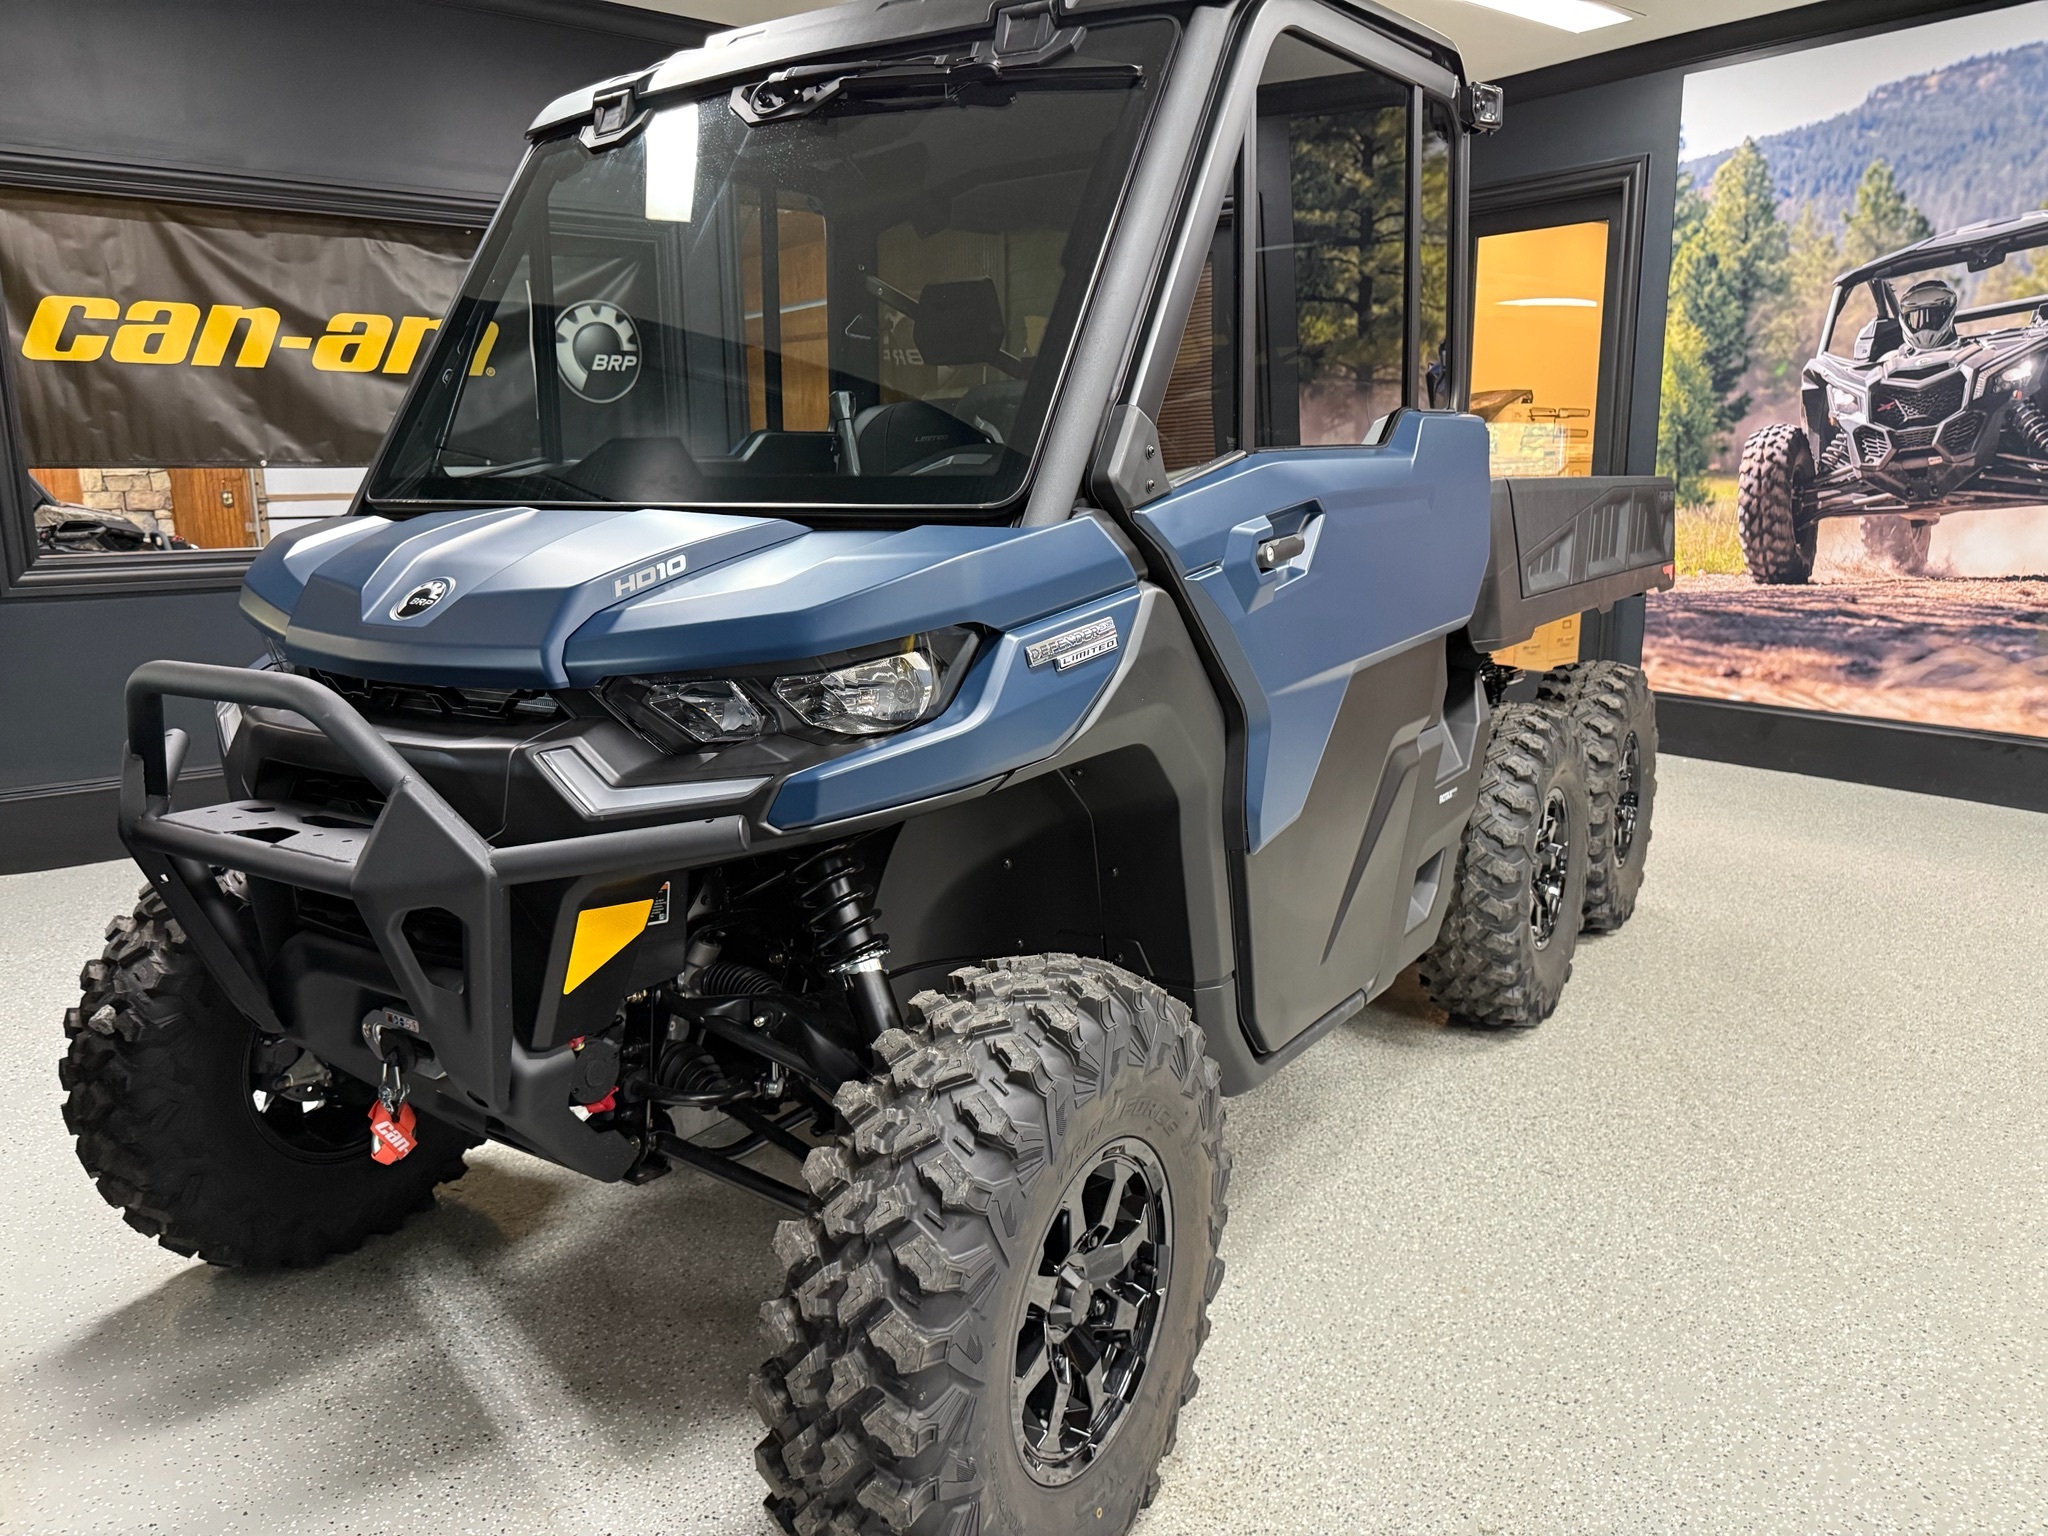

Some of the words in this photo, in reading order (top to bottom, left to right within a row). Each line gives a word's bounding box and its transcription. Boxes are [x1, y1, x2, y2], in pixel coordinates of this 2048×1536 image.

[592, 354, 637, 371] BRP
[614, 554, 687, 598] HD10
[409, 597, 434, 606] BRP
[1029, 624, 1100, 660] DEFENDER
[1062, 640, 1115, 665] LIMITED
